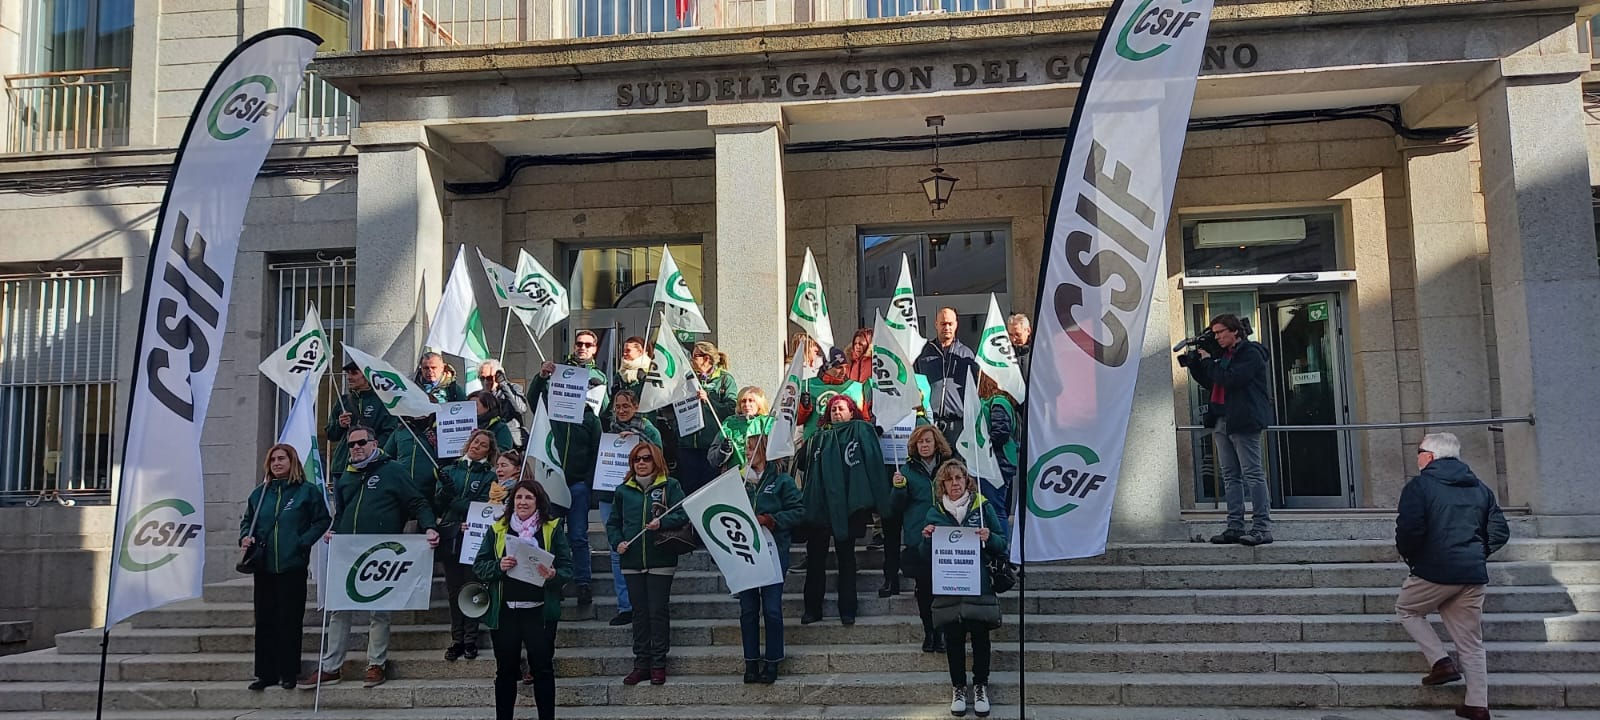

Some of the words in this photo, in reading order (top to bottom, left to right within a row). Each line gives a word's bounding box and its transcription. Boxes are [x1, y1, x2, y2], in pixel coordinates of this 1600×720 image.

[1133, 6, 1202, 39] CSIF
[617, 66, 934, 107] SUBDELEGACION
[953, 56, 1028, 88] DEL
[223, 93, 279, 123] CSIF
[1053, 138, 1156, 368] CSIF
[147, 210, 225, 423] CSIF
[1039, 465, 1107, 499] CSIF
[134, 520, 203, 547] CSIF
[720, 516, 755, 565] CSIF
[359, 560, 414, 581] CSIF
